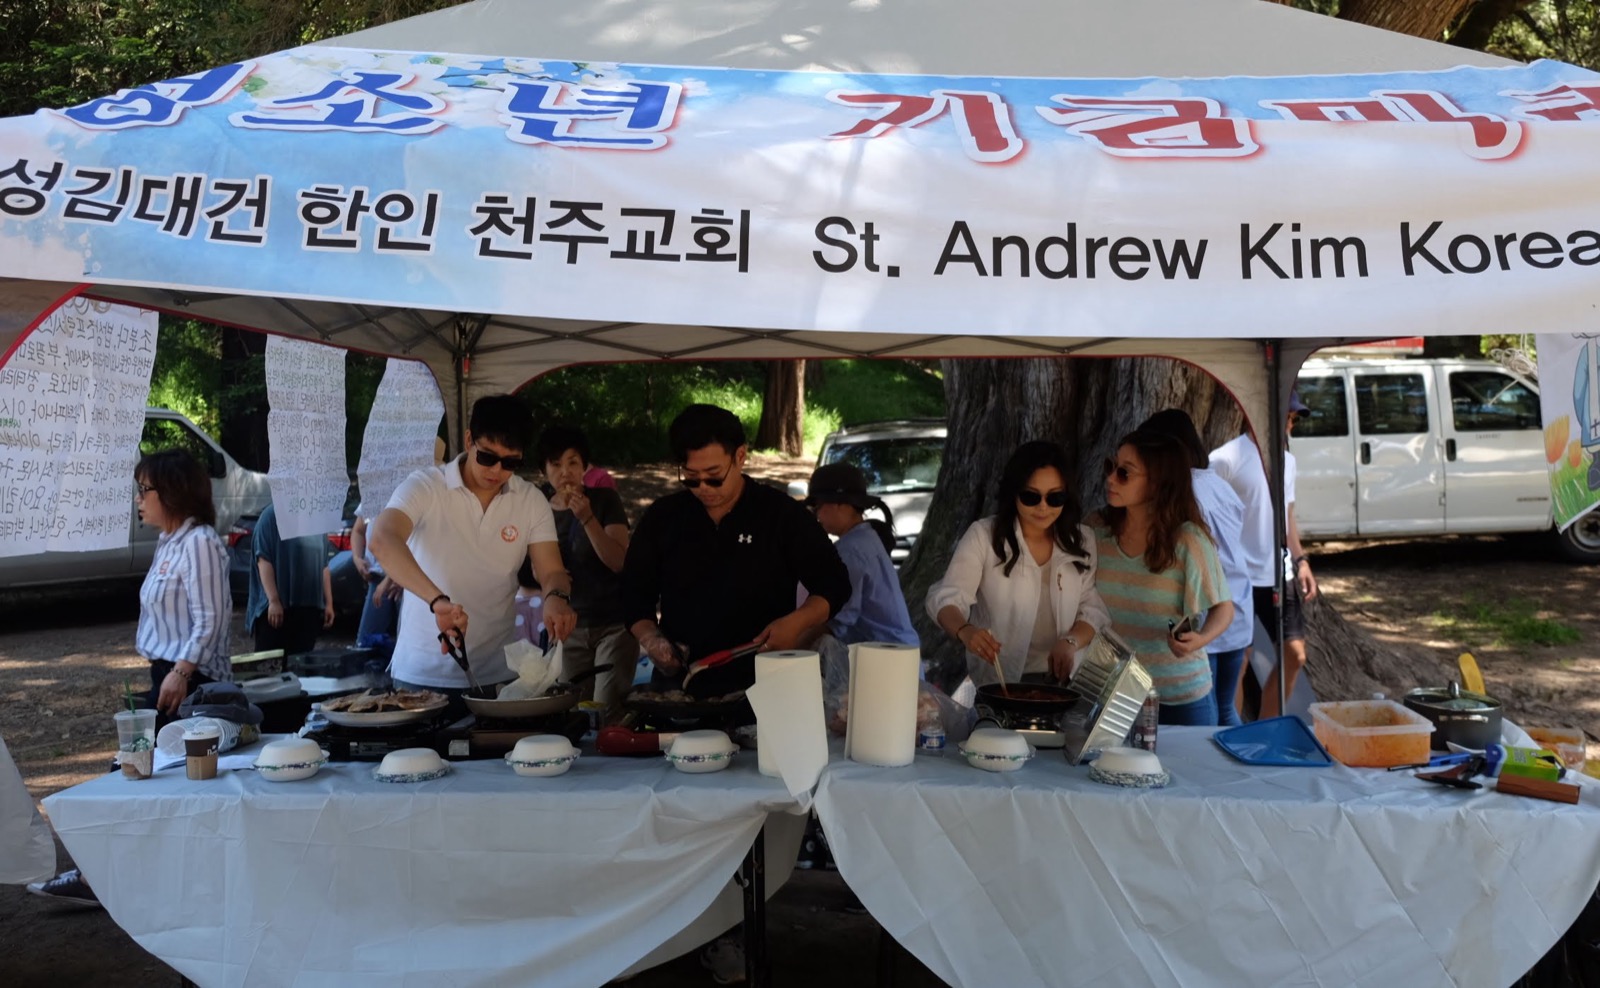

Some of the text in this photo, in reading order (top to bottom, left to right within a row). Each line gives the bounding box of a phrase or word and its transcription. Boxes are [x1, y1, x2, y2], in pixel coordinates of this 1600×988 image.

[0, 158, 751, 273] 성김대건 한인 천주교회
[812, 216, 1600, 281] St. Andrew Kim Korea
